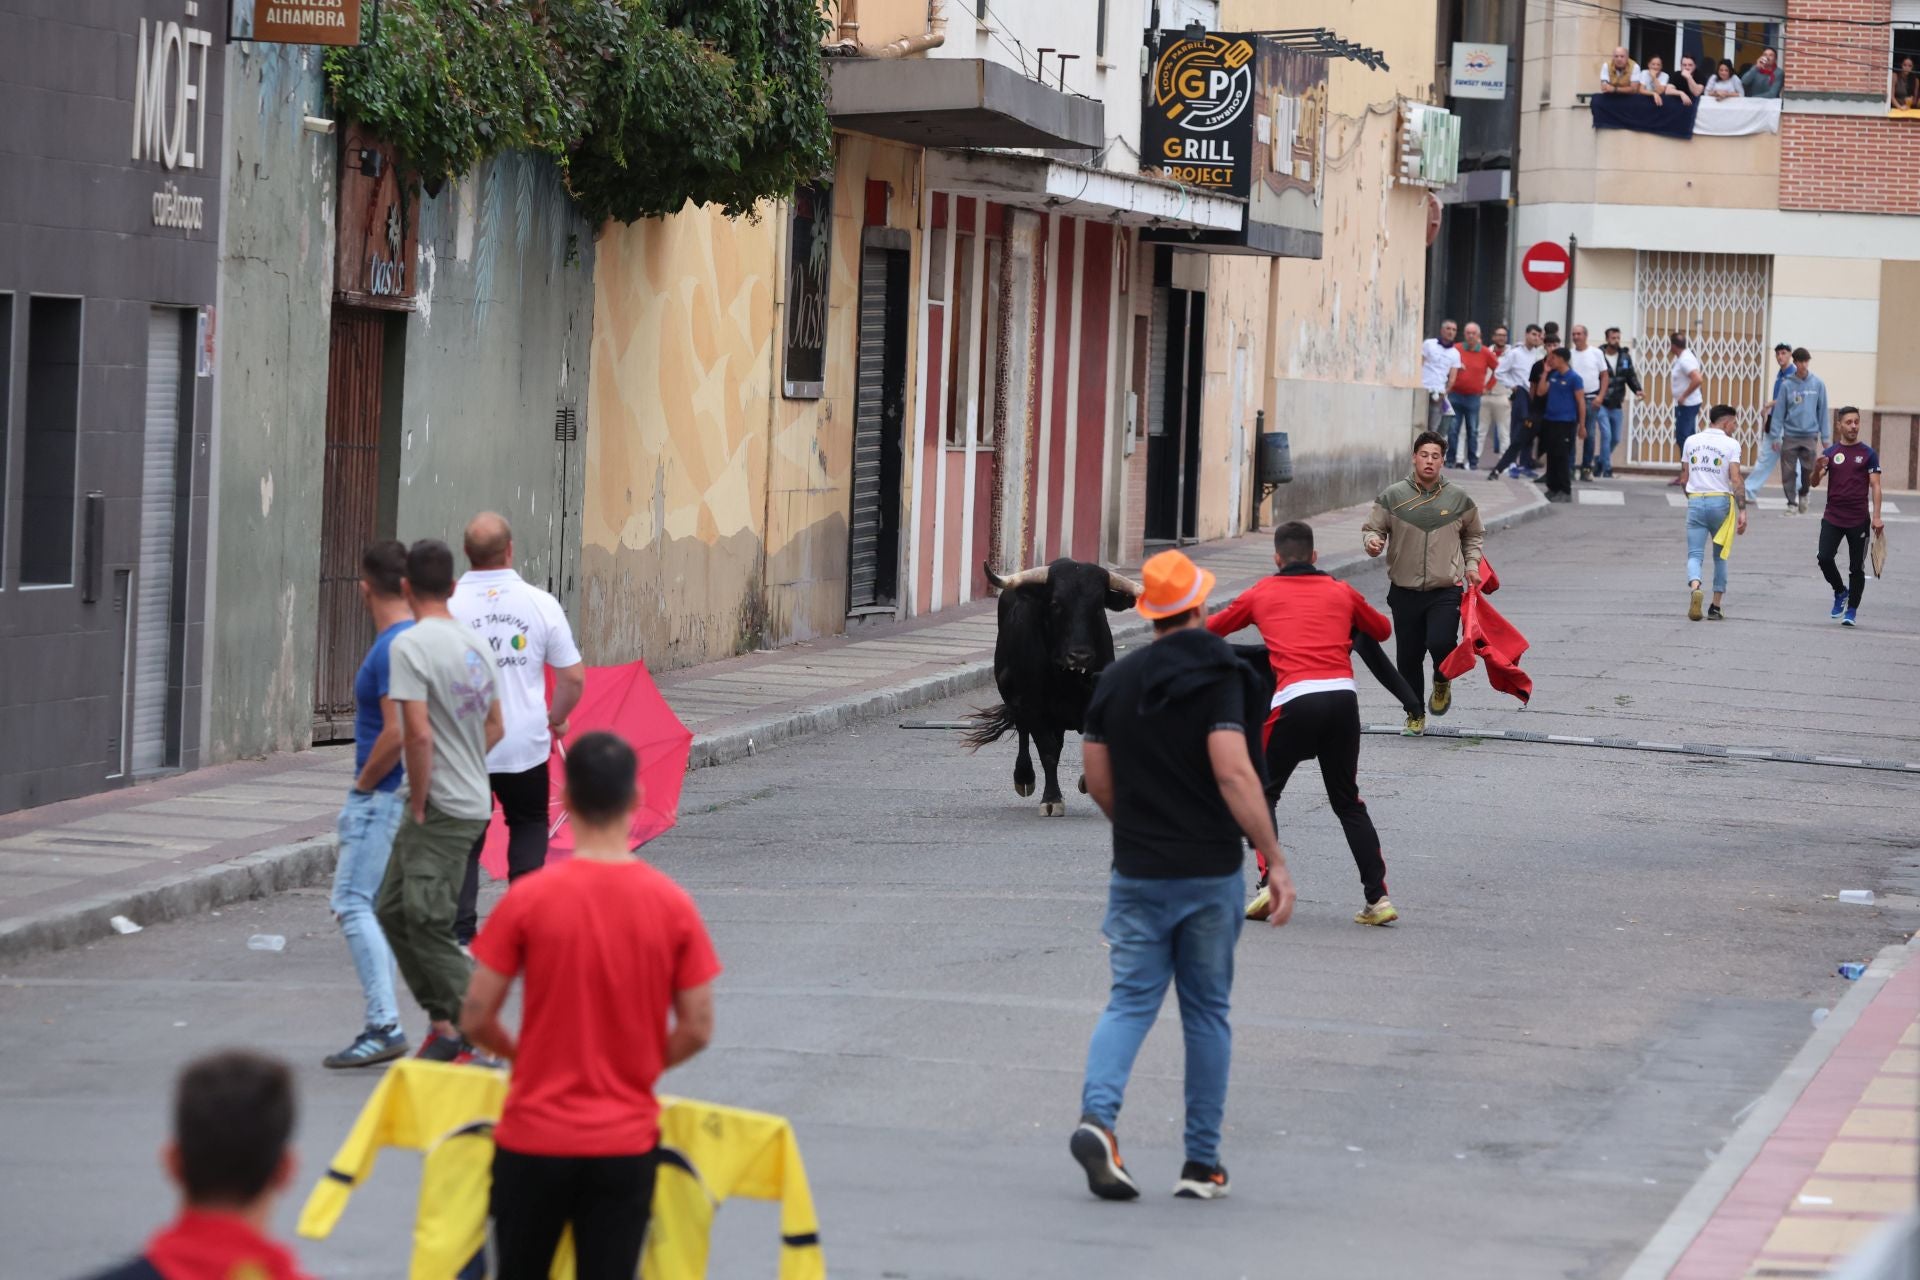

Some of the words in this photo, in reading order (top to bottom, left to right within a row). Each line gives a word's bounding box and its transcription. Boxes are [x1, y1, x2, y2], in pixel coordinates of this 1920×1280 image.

[266, 7, 346, 28] ALHAMBRA
[272, 0, 342, 8] EZAS
[1162, 61, 1174, 91] 100%
[1171, 41, 1216, 60] PARRILLA
[131, 0, 212, 170] MOËT
[1178, 68, 1230, 100] GP
[1204, 89, 1243, 125] GOURMET
[1163, 137, 1235, 161] GRILL
[1163, 165, 1234, 185] PROJECT
